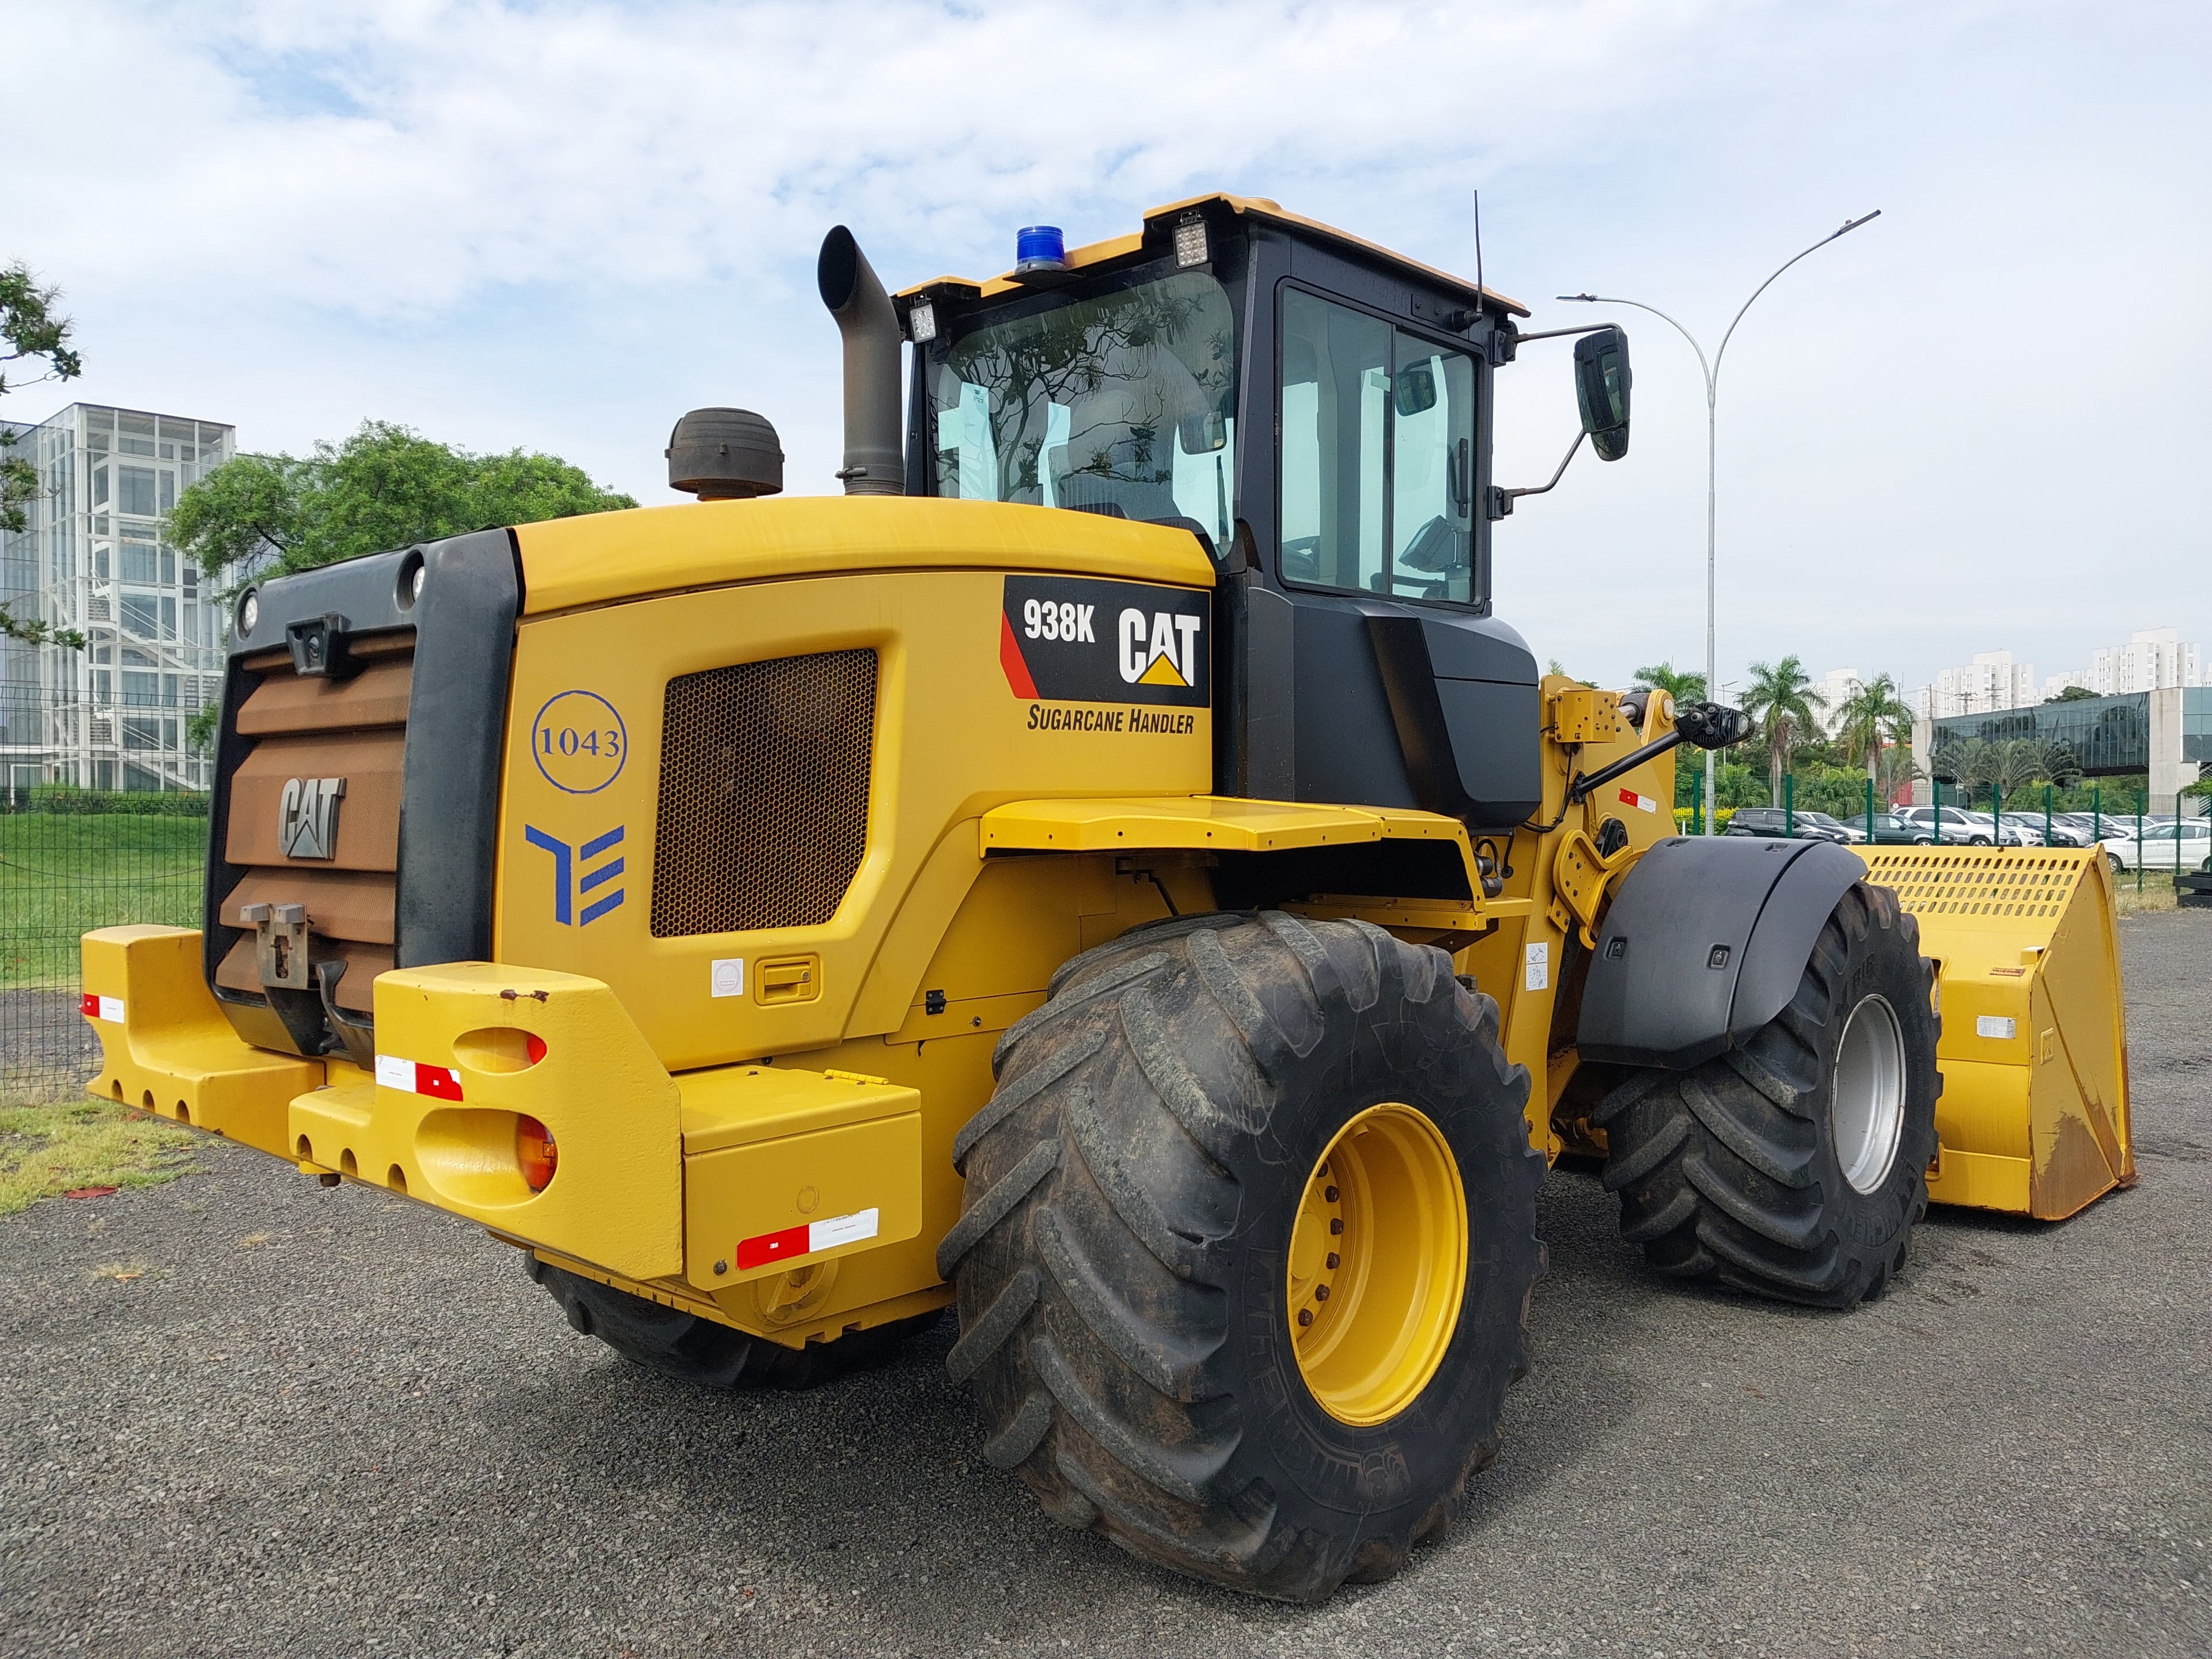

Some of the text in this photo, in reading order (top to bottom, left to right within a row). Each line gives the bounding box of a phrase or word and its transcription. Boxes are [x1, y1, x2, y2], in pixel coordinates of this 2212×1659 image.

[1024, 599, 1096, 643] 938K
[1119, 608, 1200, 687] CAT
[540, 728, 619, 758] 1043
[278, 777, 347, 860] CAT
